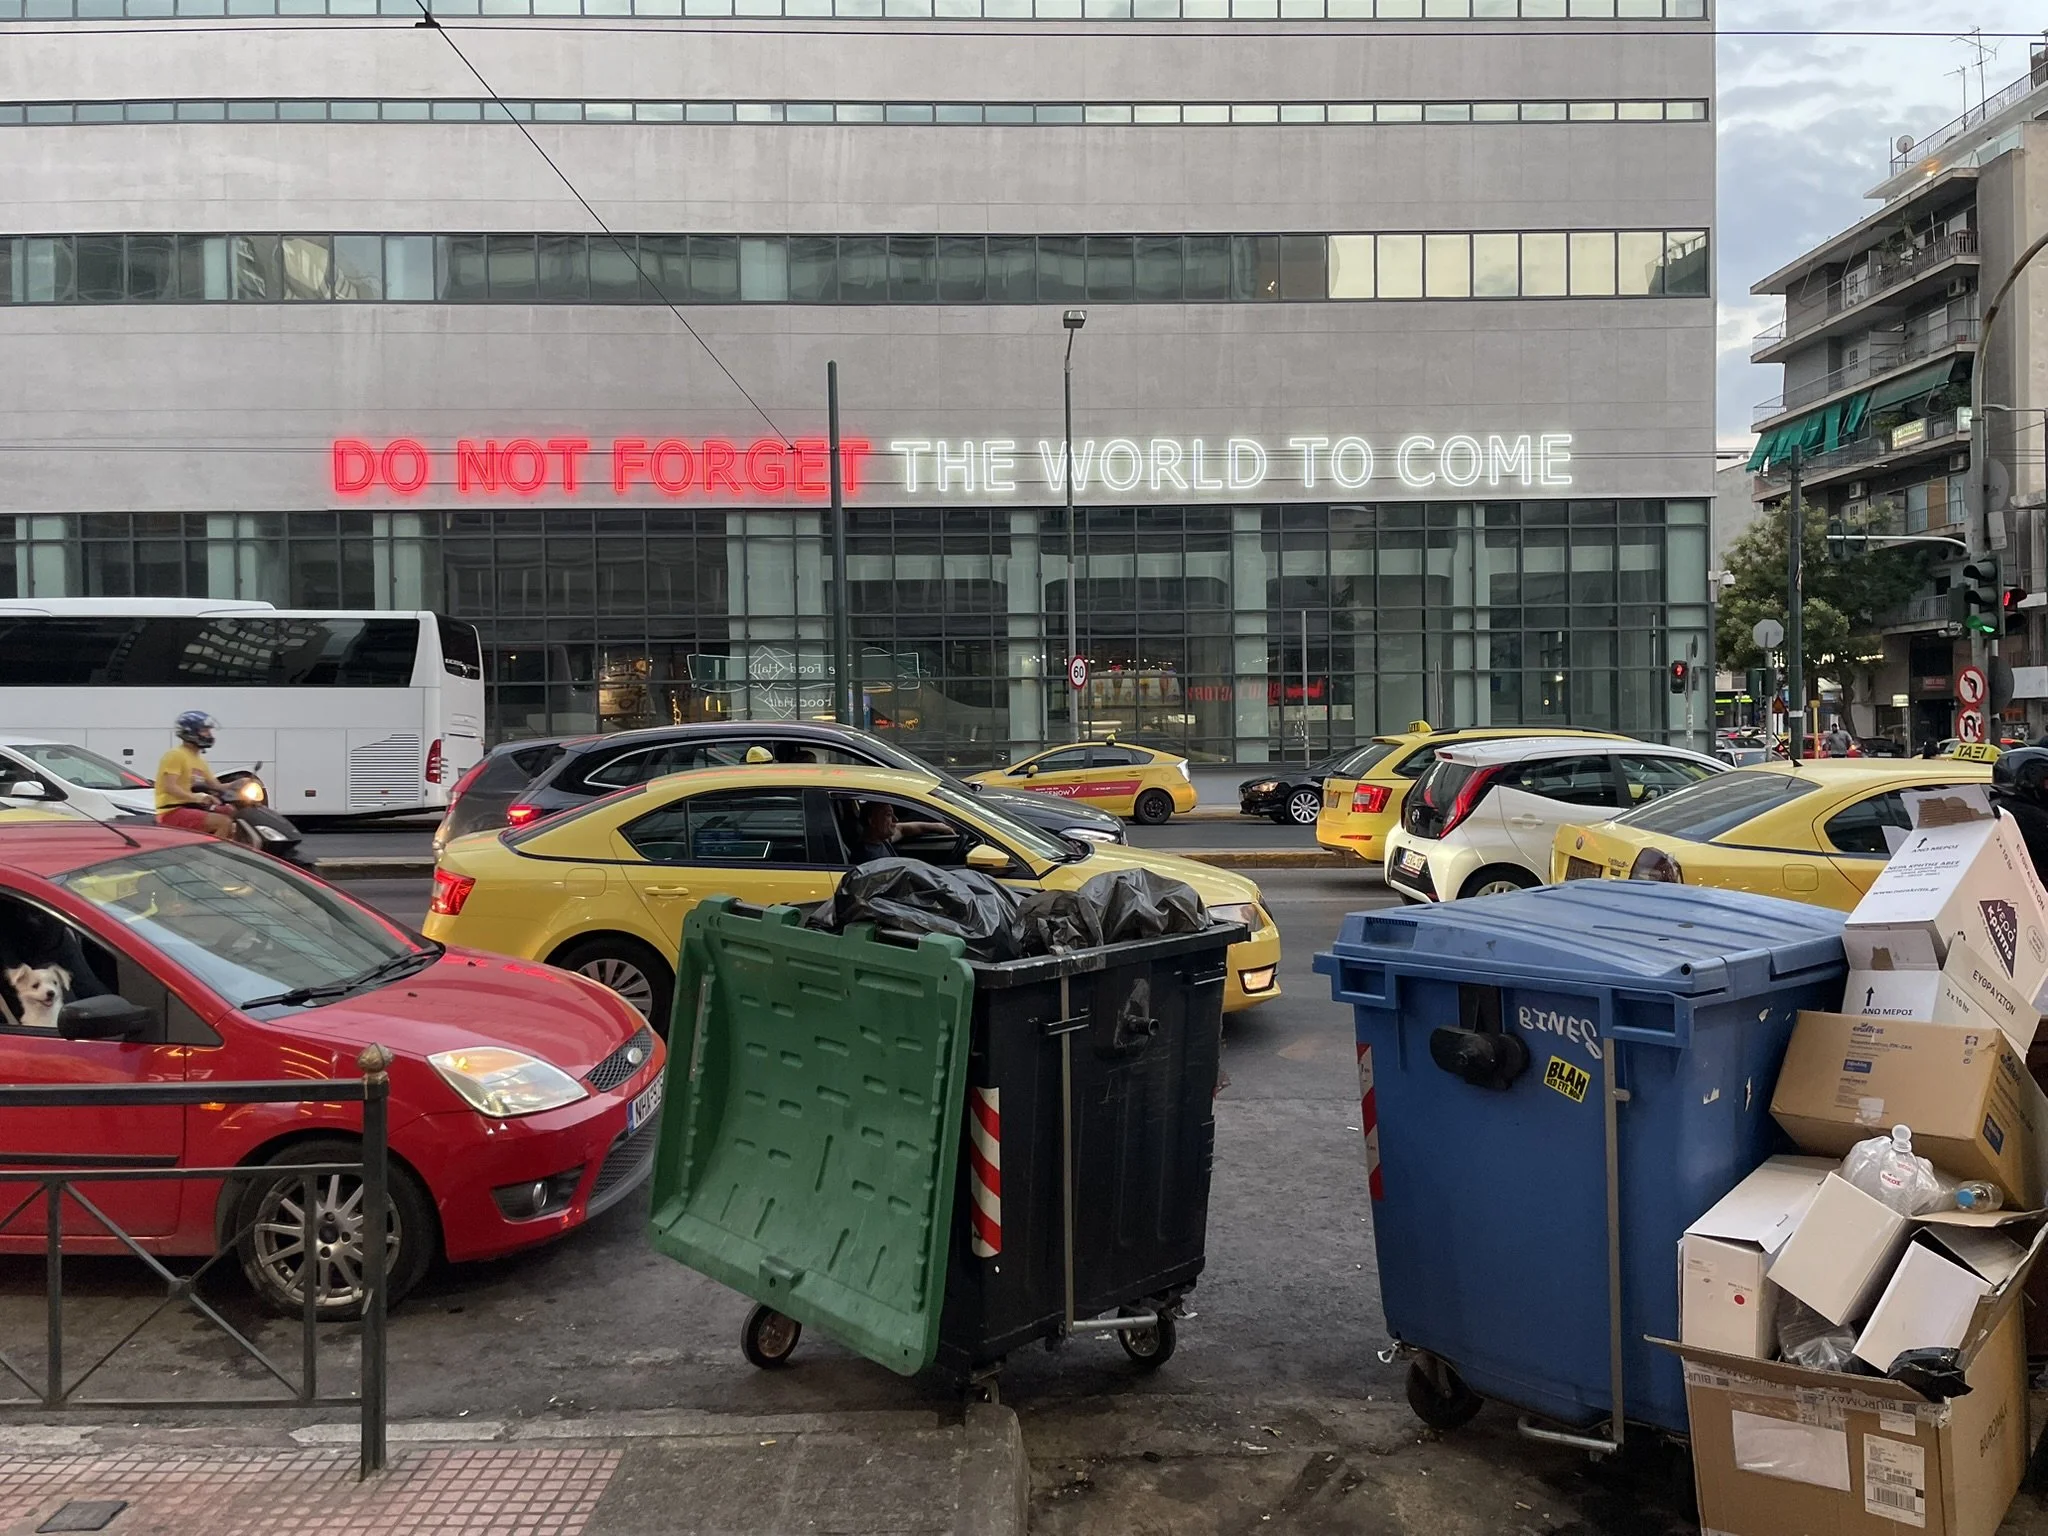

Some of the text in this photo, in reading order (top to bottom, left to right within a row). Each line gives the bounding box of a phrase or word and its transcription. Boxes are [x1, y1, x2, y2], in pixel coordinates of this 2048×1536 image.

[332, 433, 1574, 495] DO NOT FORGET THE WORLD TO COME
[1073, 665, 1084, 679] 60
[1958, 745, 1988, 759] ΤΑΞΙ
[1972, 969, 2017, 1016] ΕΥΘΡΑΥΣΤΟΝ
[1861, 1007, 1913, 1016] ΑΝΩ ΜΕΡΟΣ
[1518, 1006, 1603, 1060] BINES
[1546, 1061, 1587, 1096] BLAH
[1831, 1392, 1897, 1411] BIUROMAX
